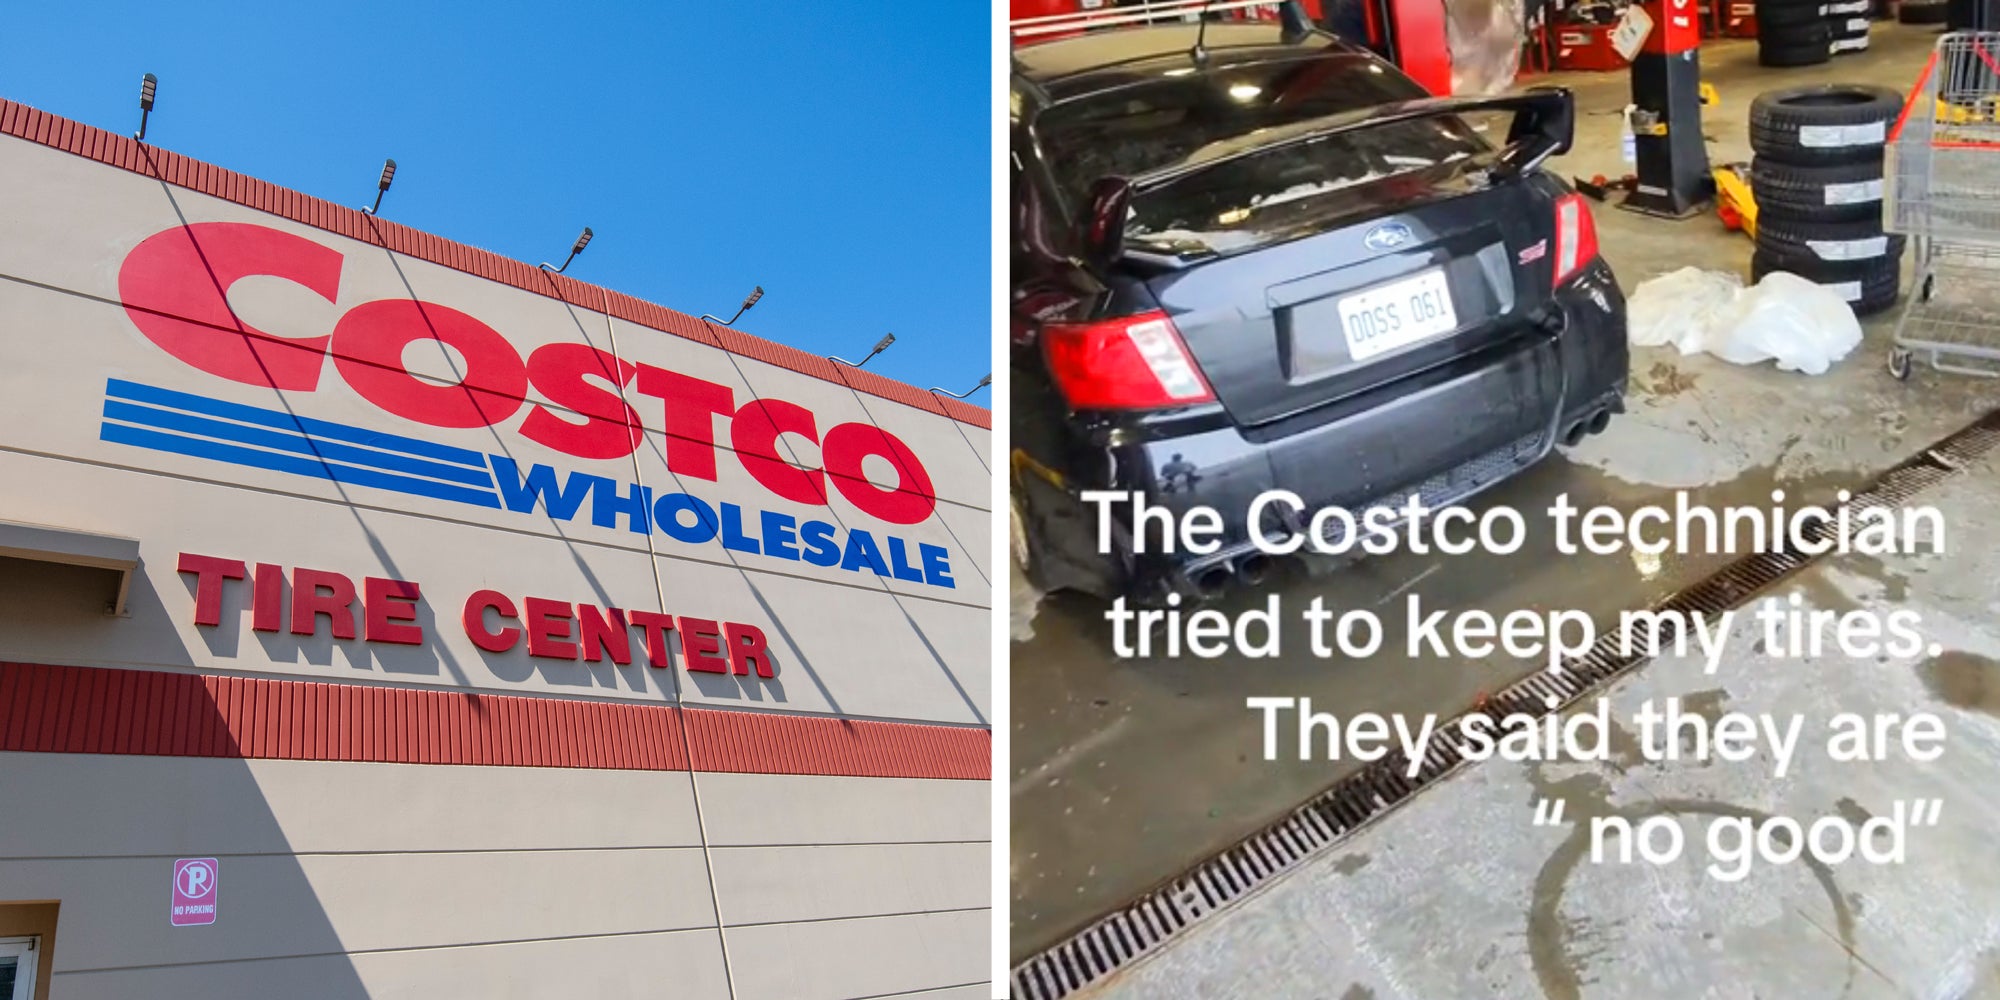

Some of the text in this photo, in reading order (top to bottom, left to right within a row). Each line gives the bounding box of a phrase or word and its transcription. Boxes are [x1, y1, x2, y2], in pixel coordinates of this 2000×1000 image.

[118, 222, 936, 525] COSTCO
[488, 453, 956, 590] WHOLESALE
[176, 552, 776, 680] TIRE CENTER
[174, 904, 214, 915] NO PARKING
